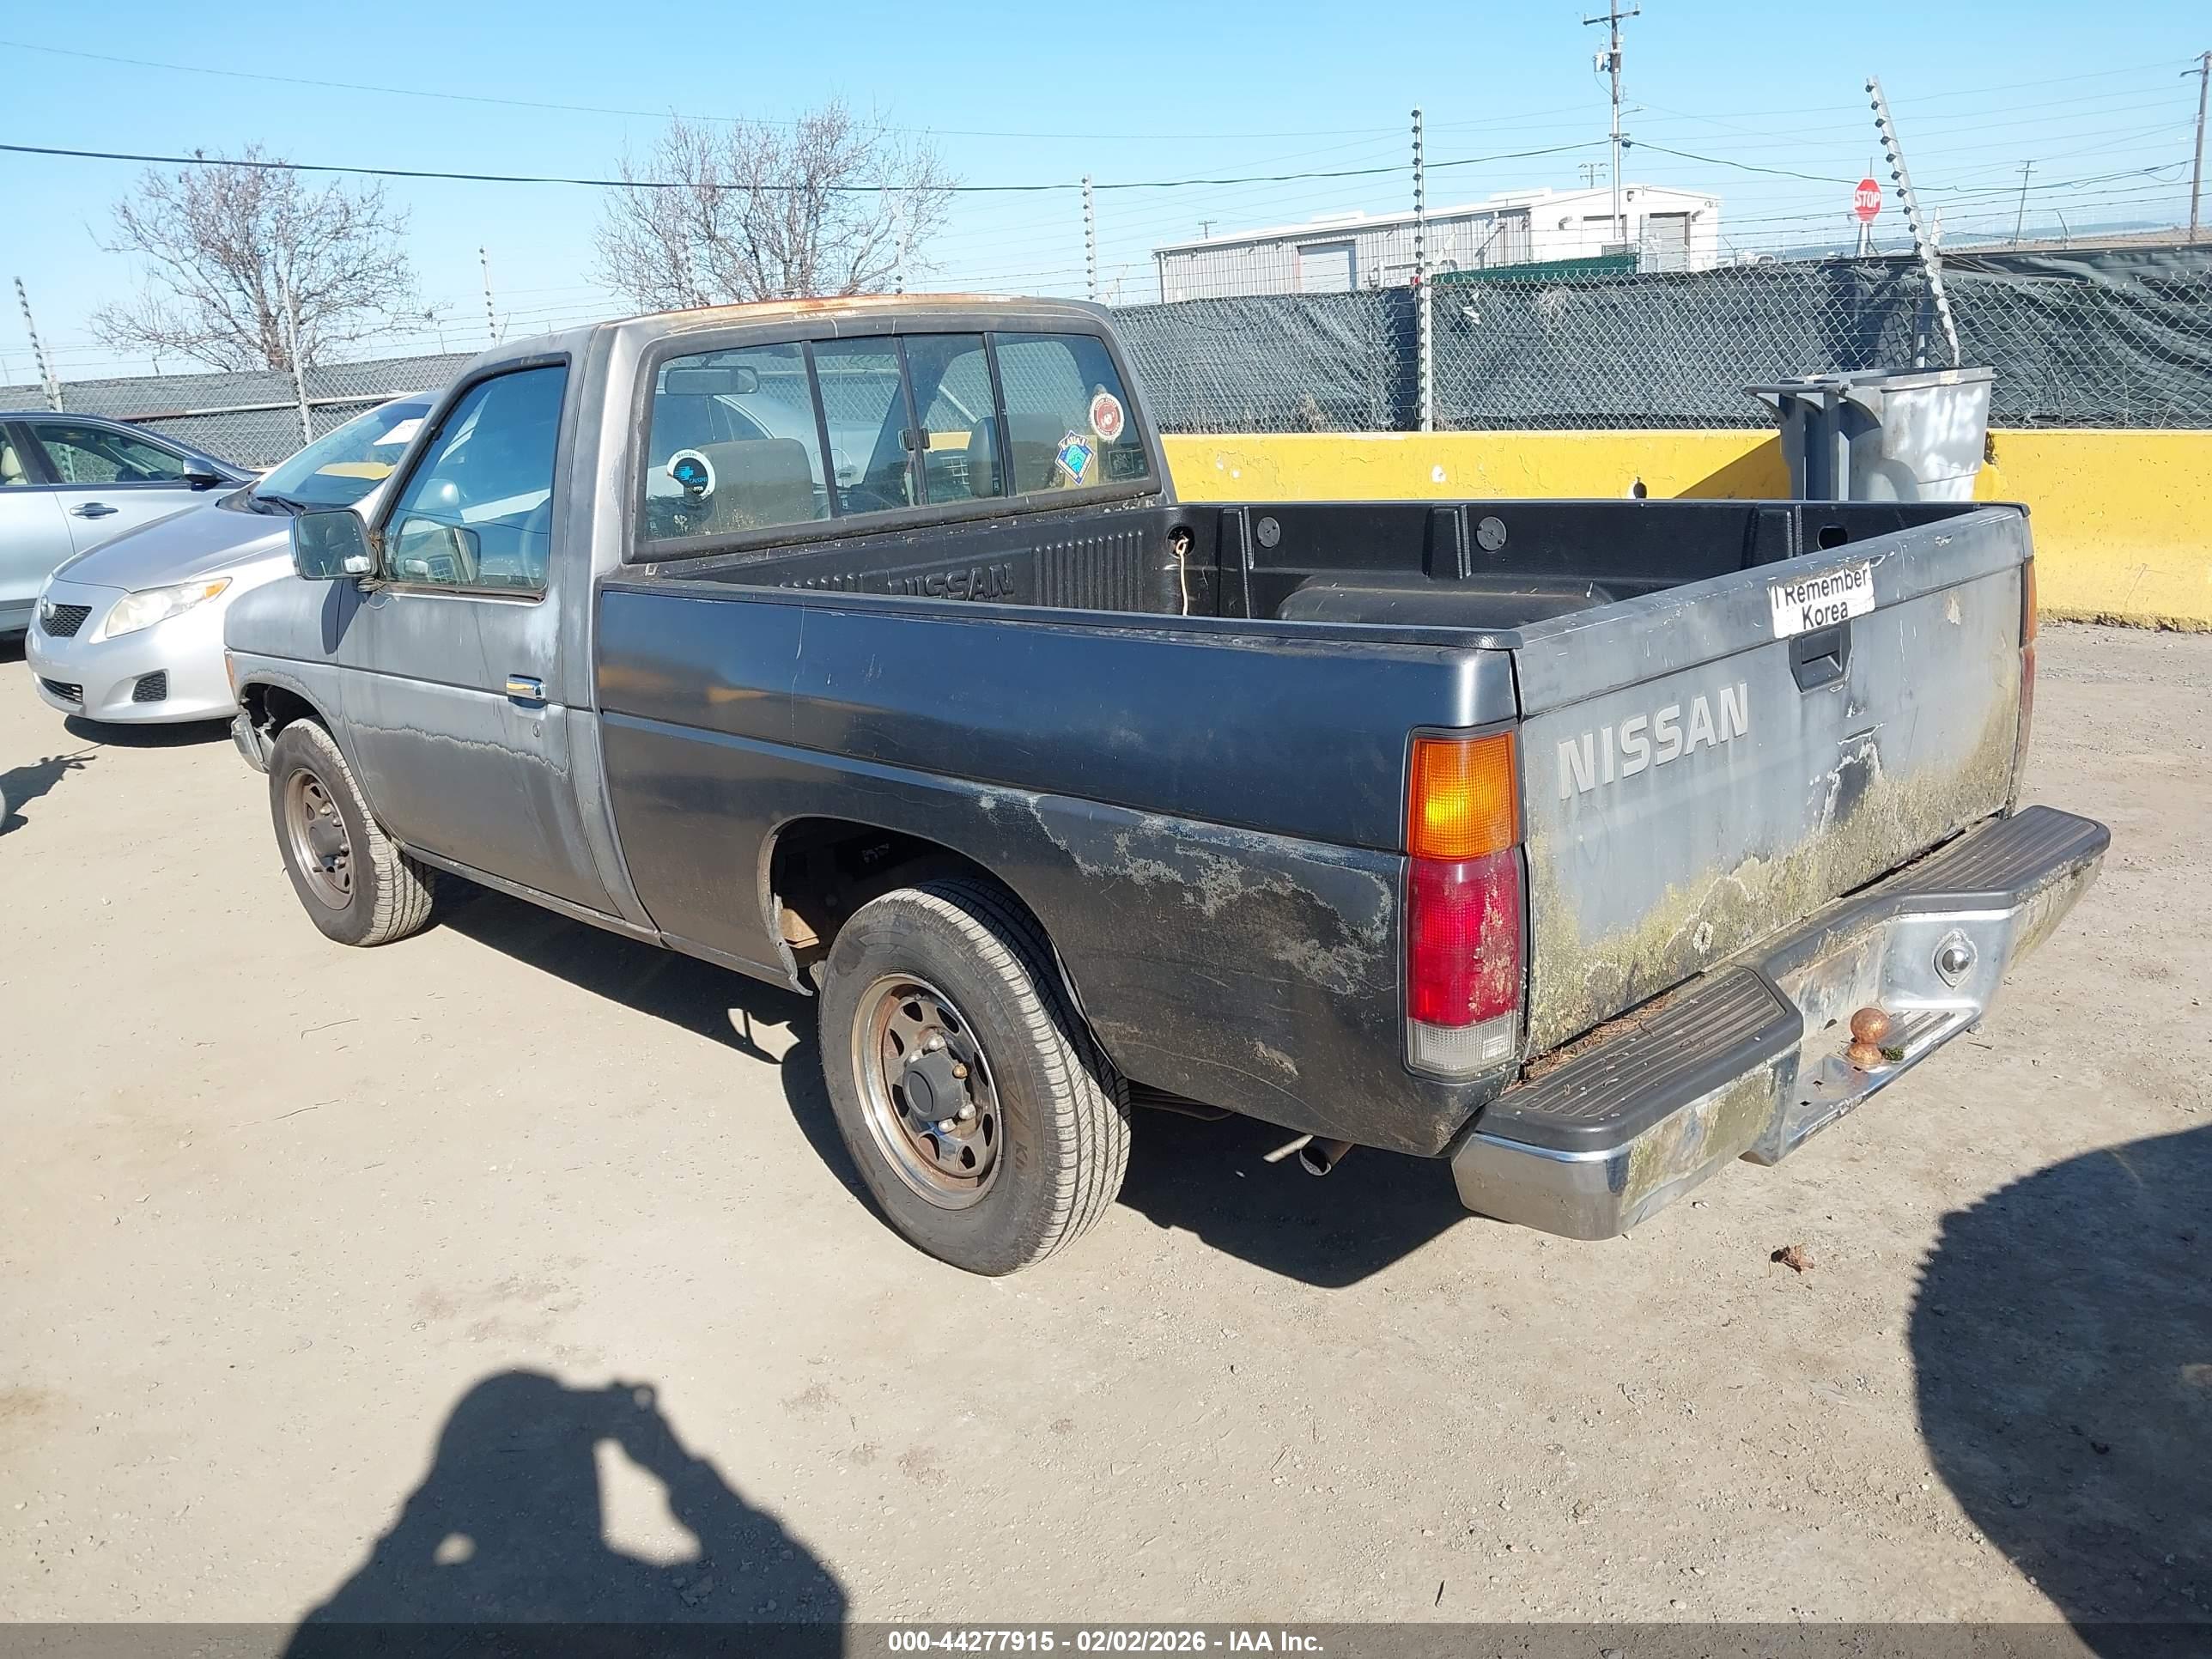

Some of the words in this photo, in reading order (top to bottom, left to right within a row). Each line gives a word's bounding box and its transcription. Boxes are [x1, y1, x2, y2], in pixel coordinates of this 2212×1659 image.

[1855, 190, 1881, 208] STOP
[1773, 585, 1780, 609] I
[1785, 568, 1868, 606] Remember
[1802, 601, 1848, 630] Korea
[1558, 681, 1748, 800] NISSAN
